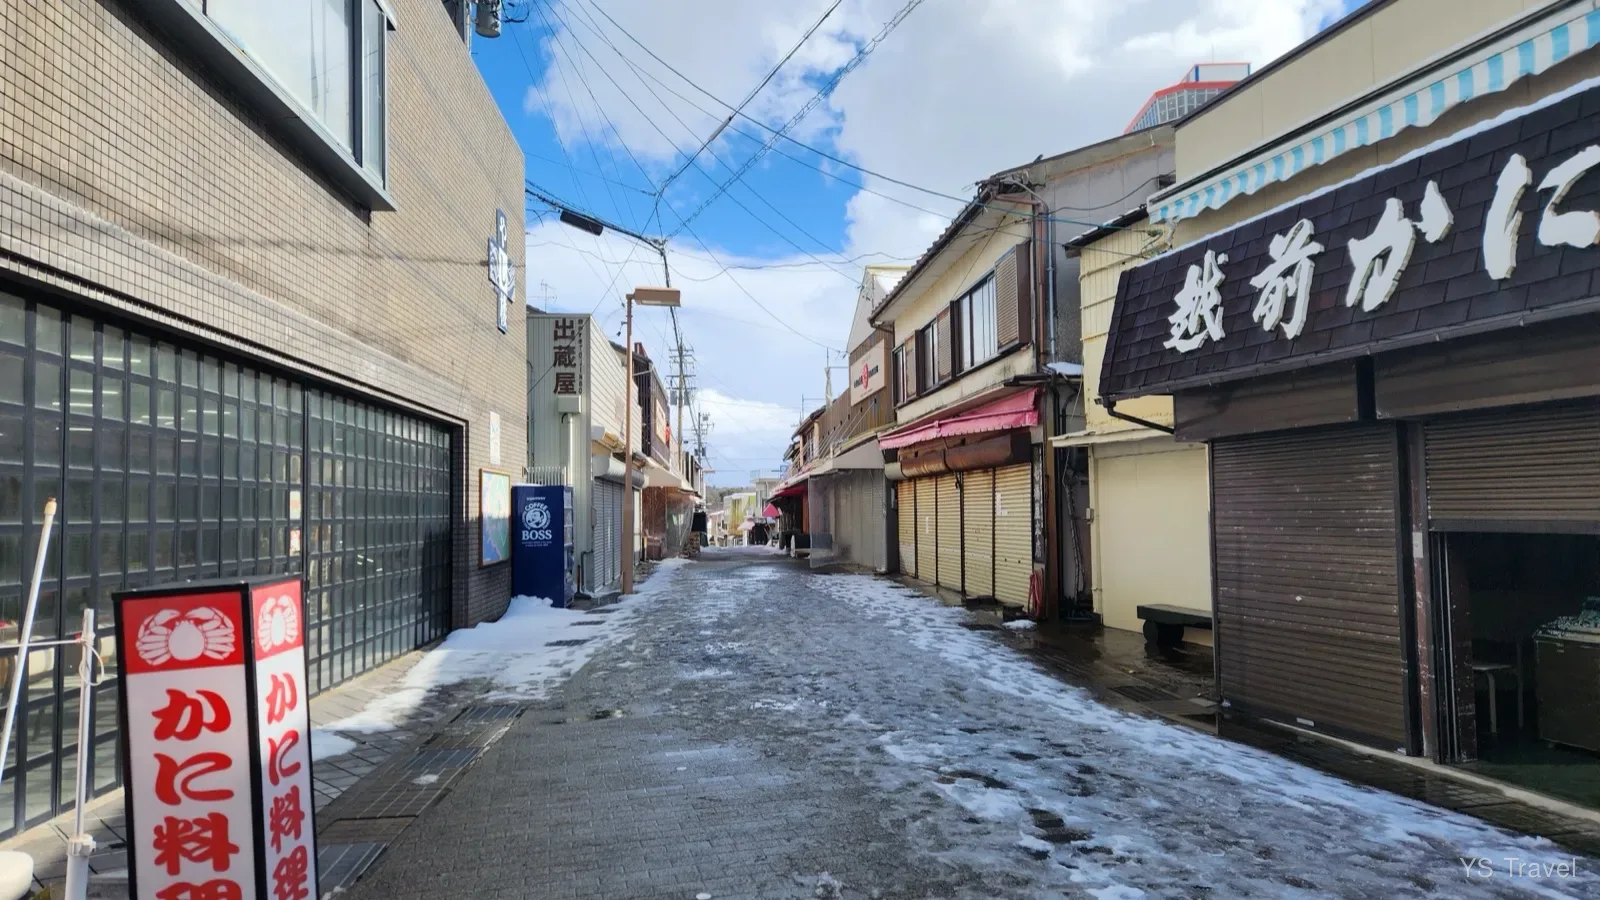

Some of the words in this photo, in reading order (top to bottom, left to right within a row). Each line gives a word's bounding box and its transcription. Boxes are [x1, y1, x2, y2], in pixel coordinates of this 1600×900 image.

[553, 317, 577, 395] 出蔵屋
[525, 502, 548, 511] COFFEE
[521, 529, 552, 541] BOSS
[265, 673, 308, 900] かに料理
